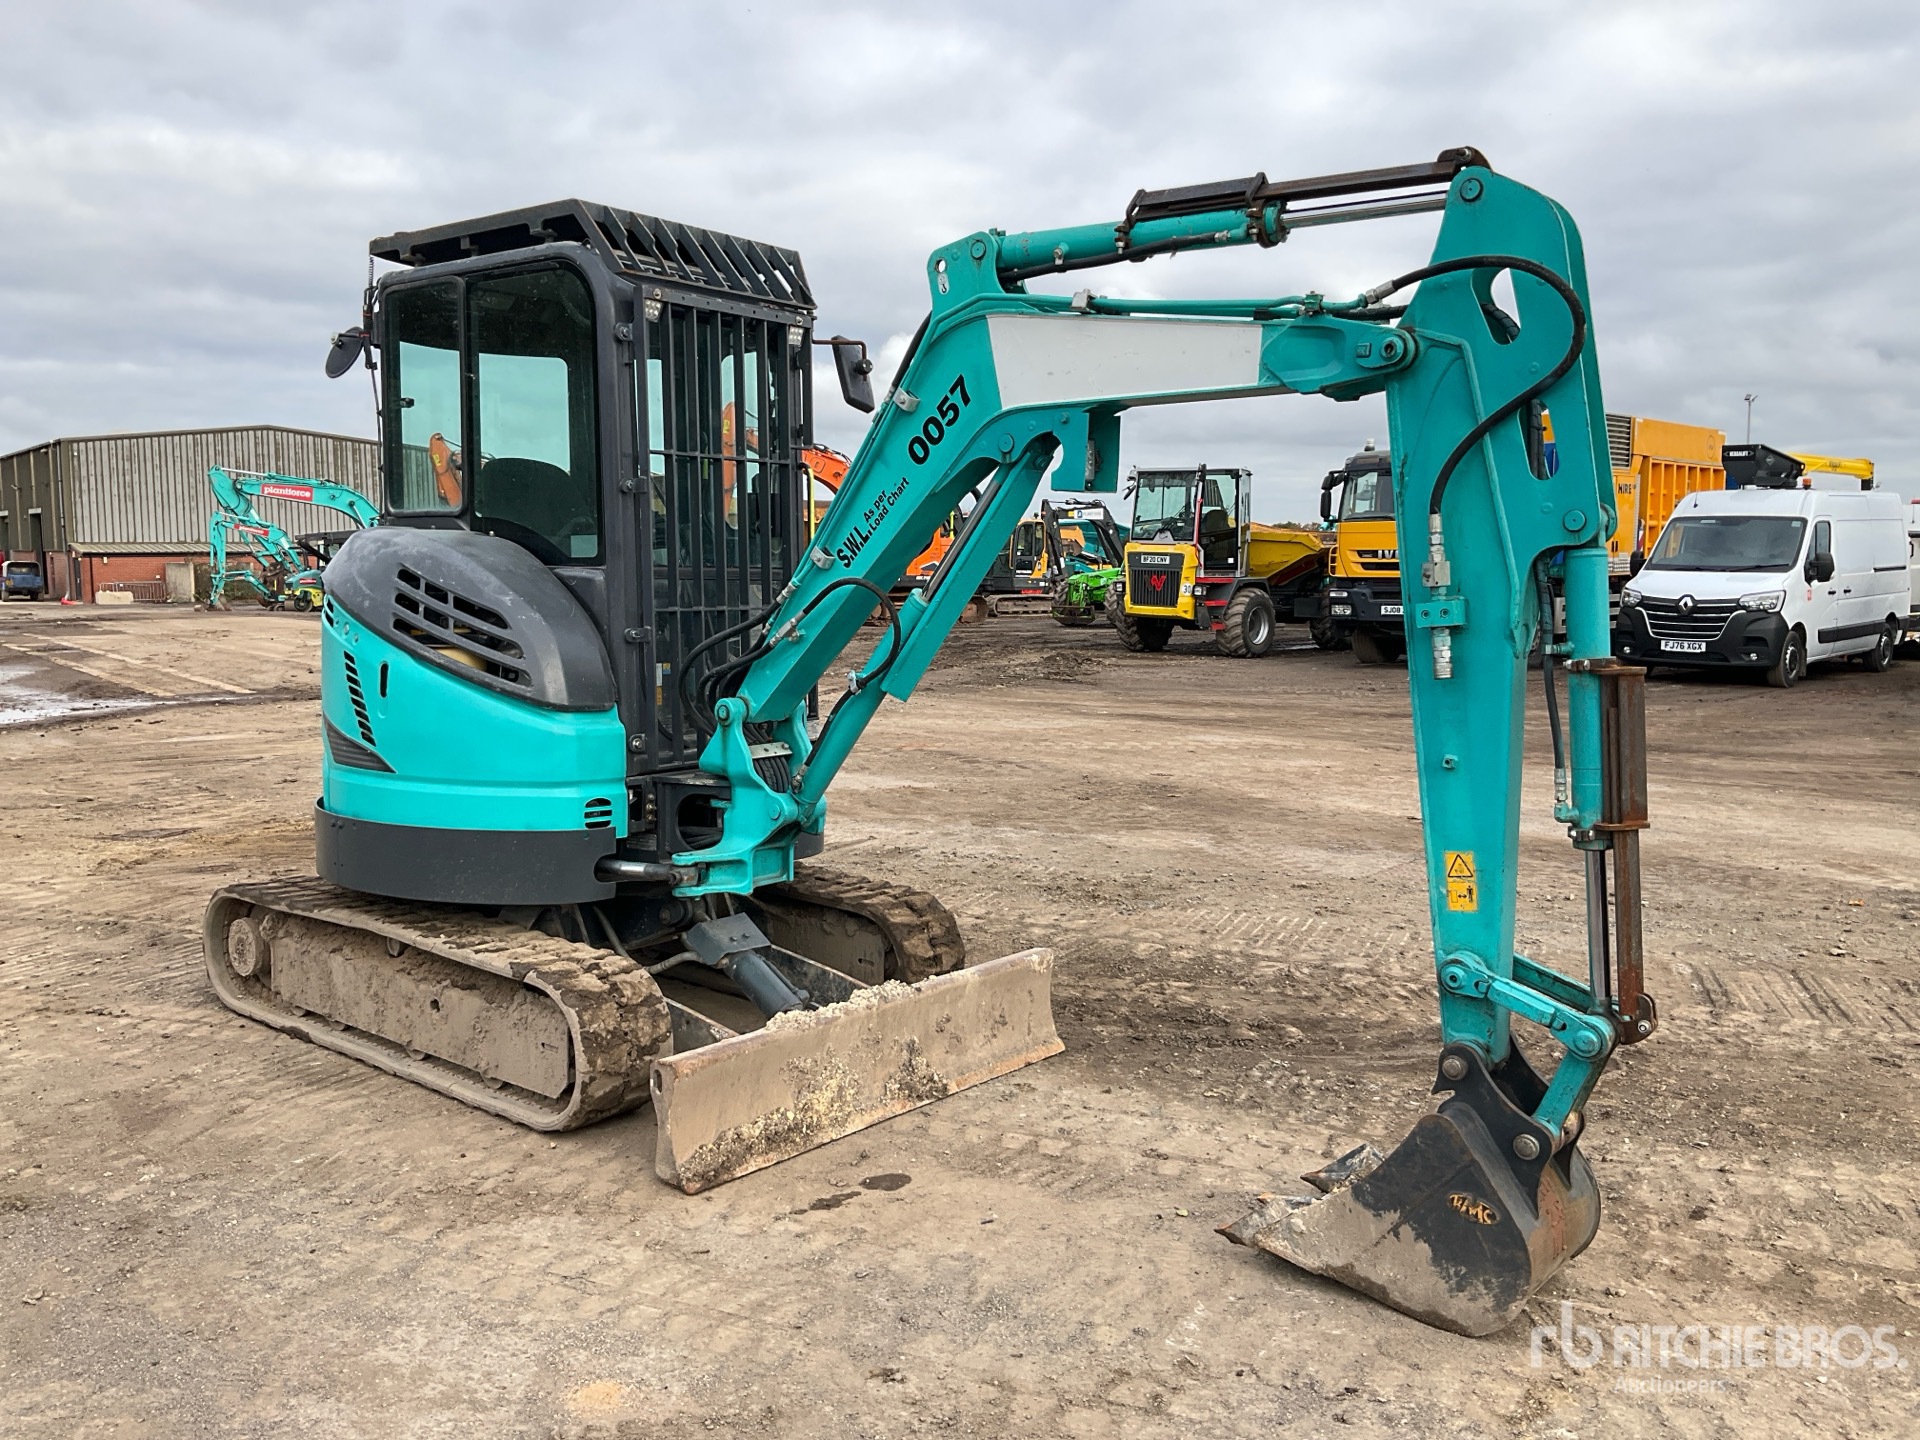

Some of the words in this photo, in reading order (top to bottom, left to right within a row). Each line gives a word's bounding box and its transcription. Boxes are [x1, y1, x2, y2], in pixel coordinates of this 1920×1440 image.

[907, 373, 972, 465] 0057
[263, 486, 312, 498] plantforce
[868, 504, 890, 531] Load
[886, 476, 910, 507] Chart
[863, 508, 875, 523] As
[873, 489, 888, 510] per
[1183, 584, 1192, 594] 30
[1664, 641, 1685, 650] FJ76
[1686, 642, 1703, 651] XGX
